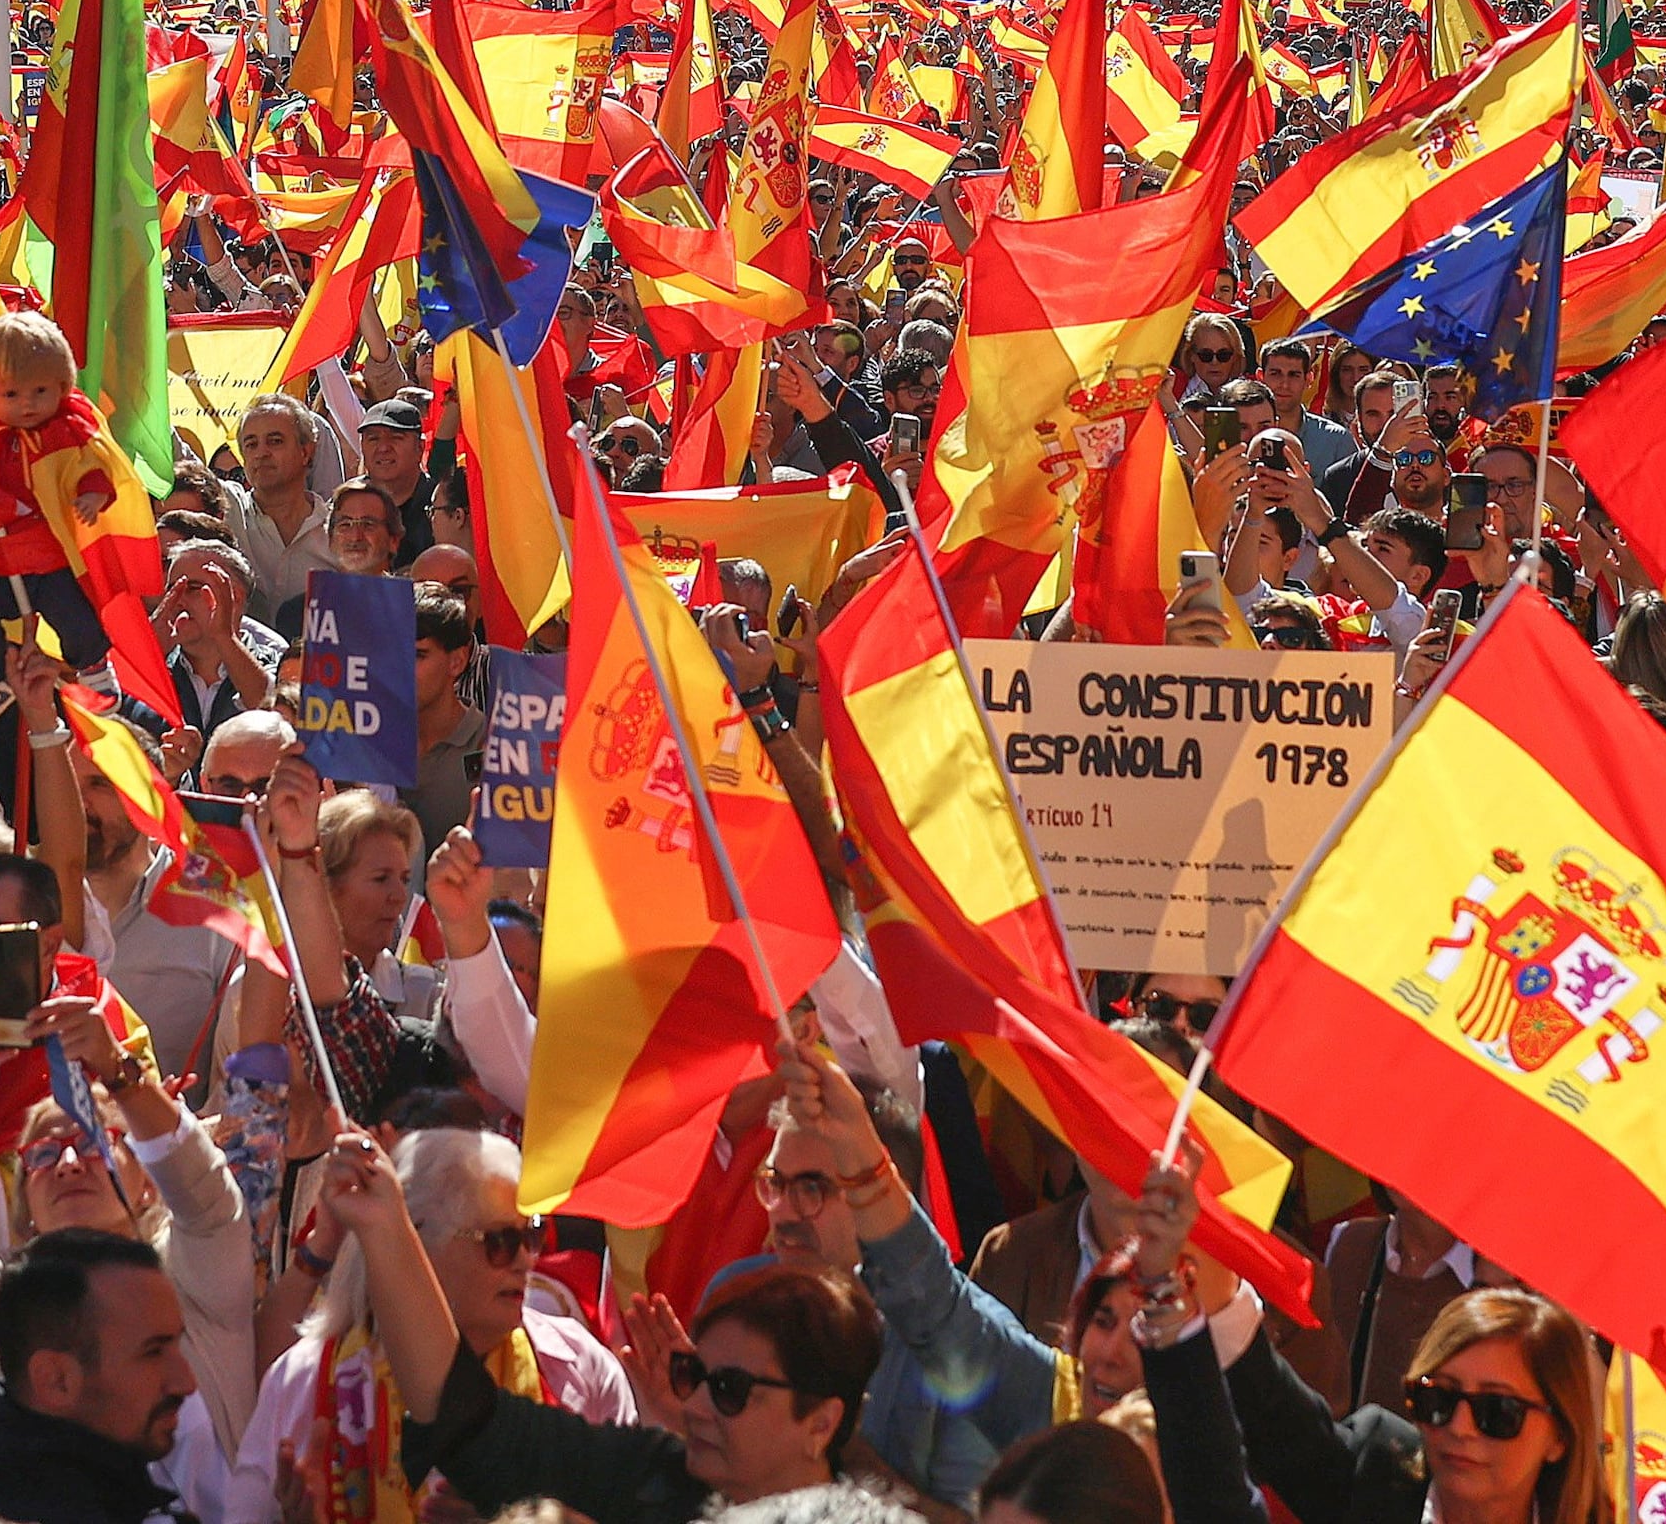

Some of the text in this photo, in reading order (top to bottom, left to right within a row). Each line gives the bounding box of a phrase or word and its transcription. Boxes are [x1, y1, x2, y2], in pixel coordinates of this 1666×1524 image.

[27, 87, 41, 97] EN
[347, 655, 368, 691] E
[982, 668, 1373, 728] LA CONSTITUCIÓN
[484, 736, 530, 775] EN
[1005, 725, 1350, 788] ESPAÑOLA 1978
[481, 782, 554, 822] IGU
[1018, 794, 1114, 828] RTÍCULO 14
